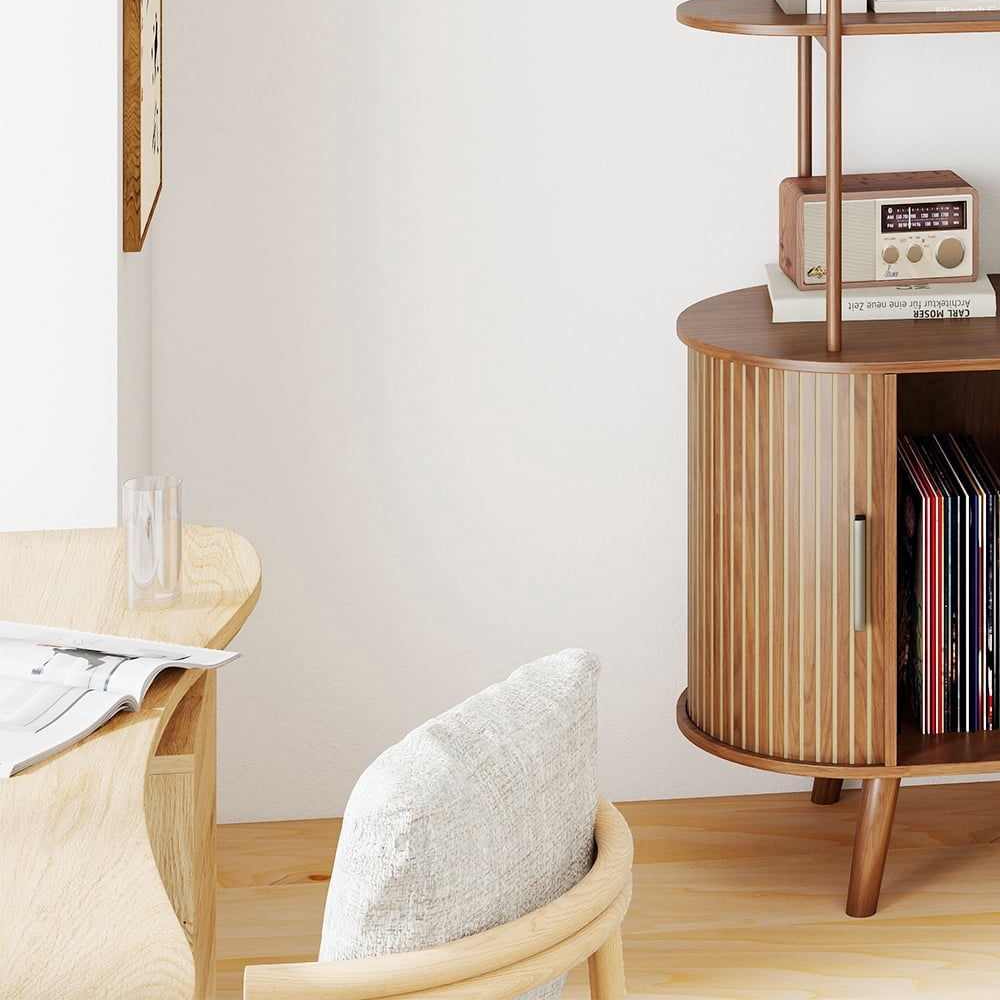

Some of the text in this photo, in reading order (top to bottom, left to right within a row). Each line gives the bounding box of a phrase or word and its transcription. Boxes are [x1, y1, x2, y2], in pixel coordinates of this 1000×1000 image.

[848, 299, 971, 311] Architektur für eine neue Zeit
[913, 309, 970, 319] CARL MOSER
